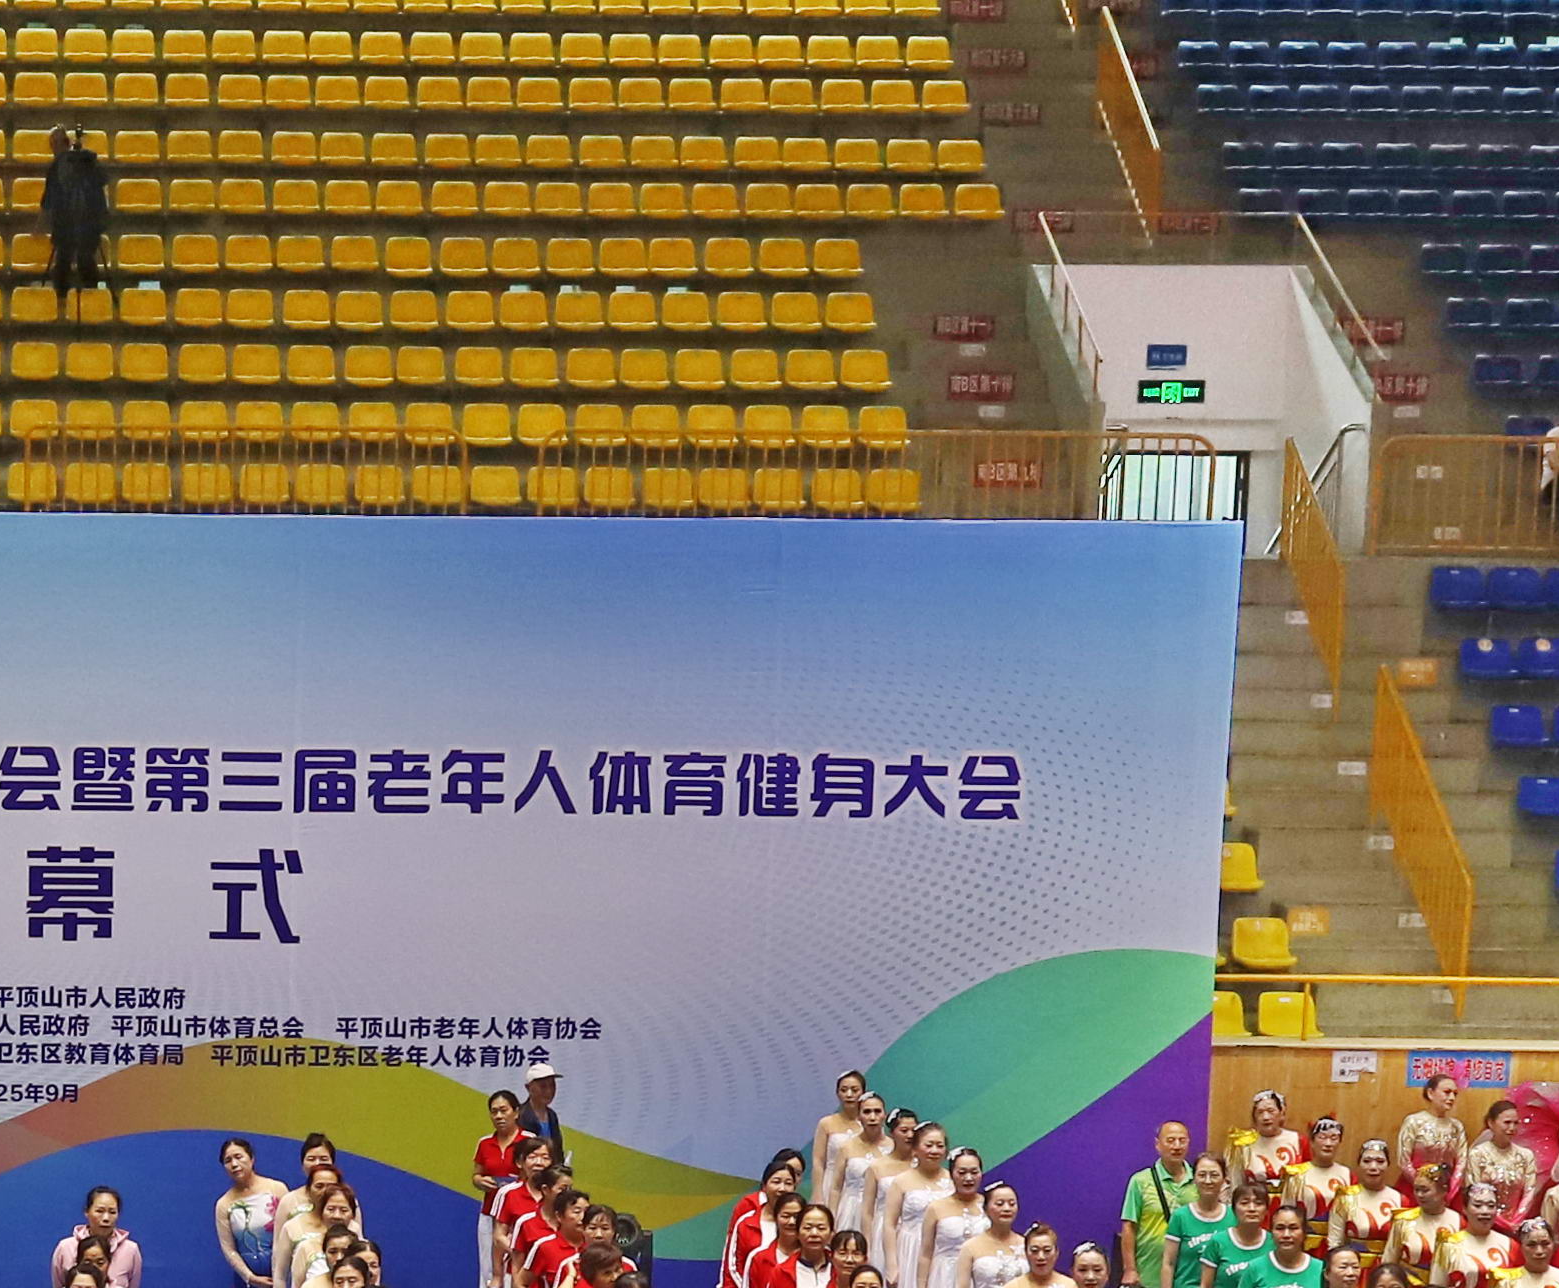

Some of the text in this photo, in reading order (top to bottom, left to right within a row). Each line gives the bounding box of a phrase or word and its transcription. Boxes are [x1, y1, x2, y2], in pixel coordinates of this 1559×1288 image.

[111, 1015, 305, 1040] 平顶山市体育总会
[335, 1016, 602, 1041] 平顶山市老年人体育协会
[211, 1044, 550, 1068] 平顶山市卫东区老年人体育协会
